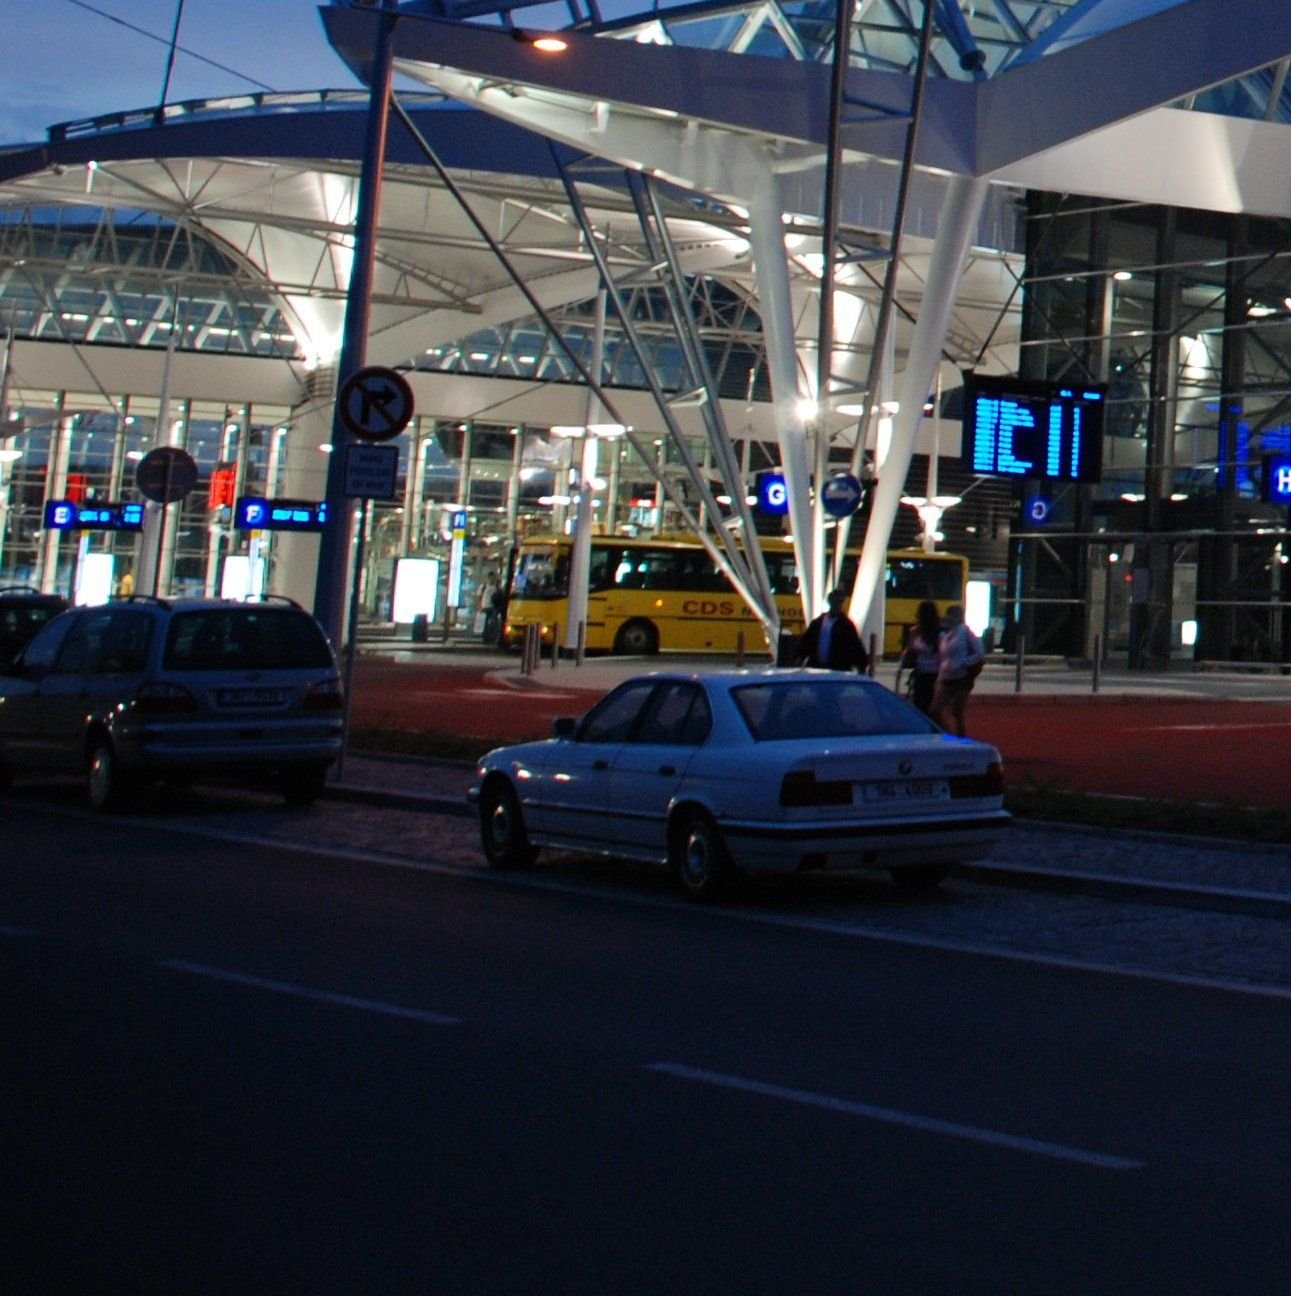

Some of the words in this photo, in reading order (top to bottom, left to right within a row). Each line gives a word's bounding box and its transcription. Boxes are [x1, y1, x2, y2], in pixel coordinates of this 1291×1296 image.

[768, 484, 786, 505] G
[54, 507, 68, 523] E
[246, 505, 260, 521] F
[682, 600, 734, 615] CDS
